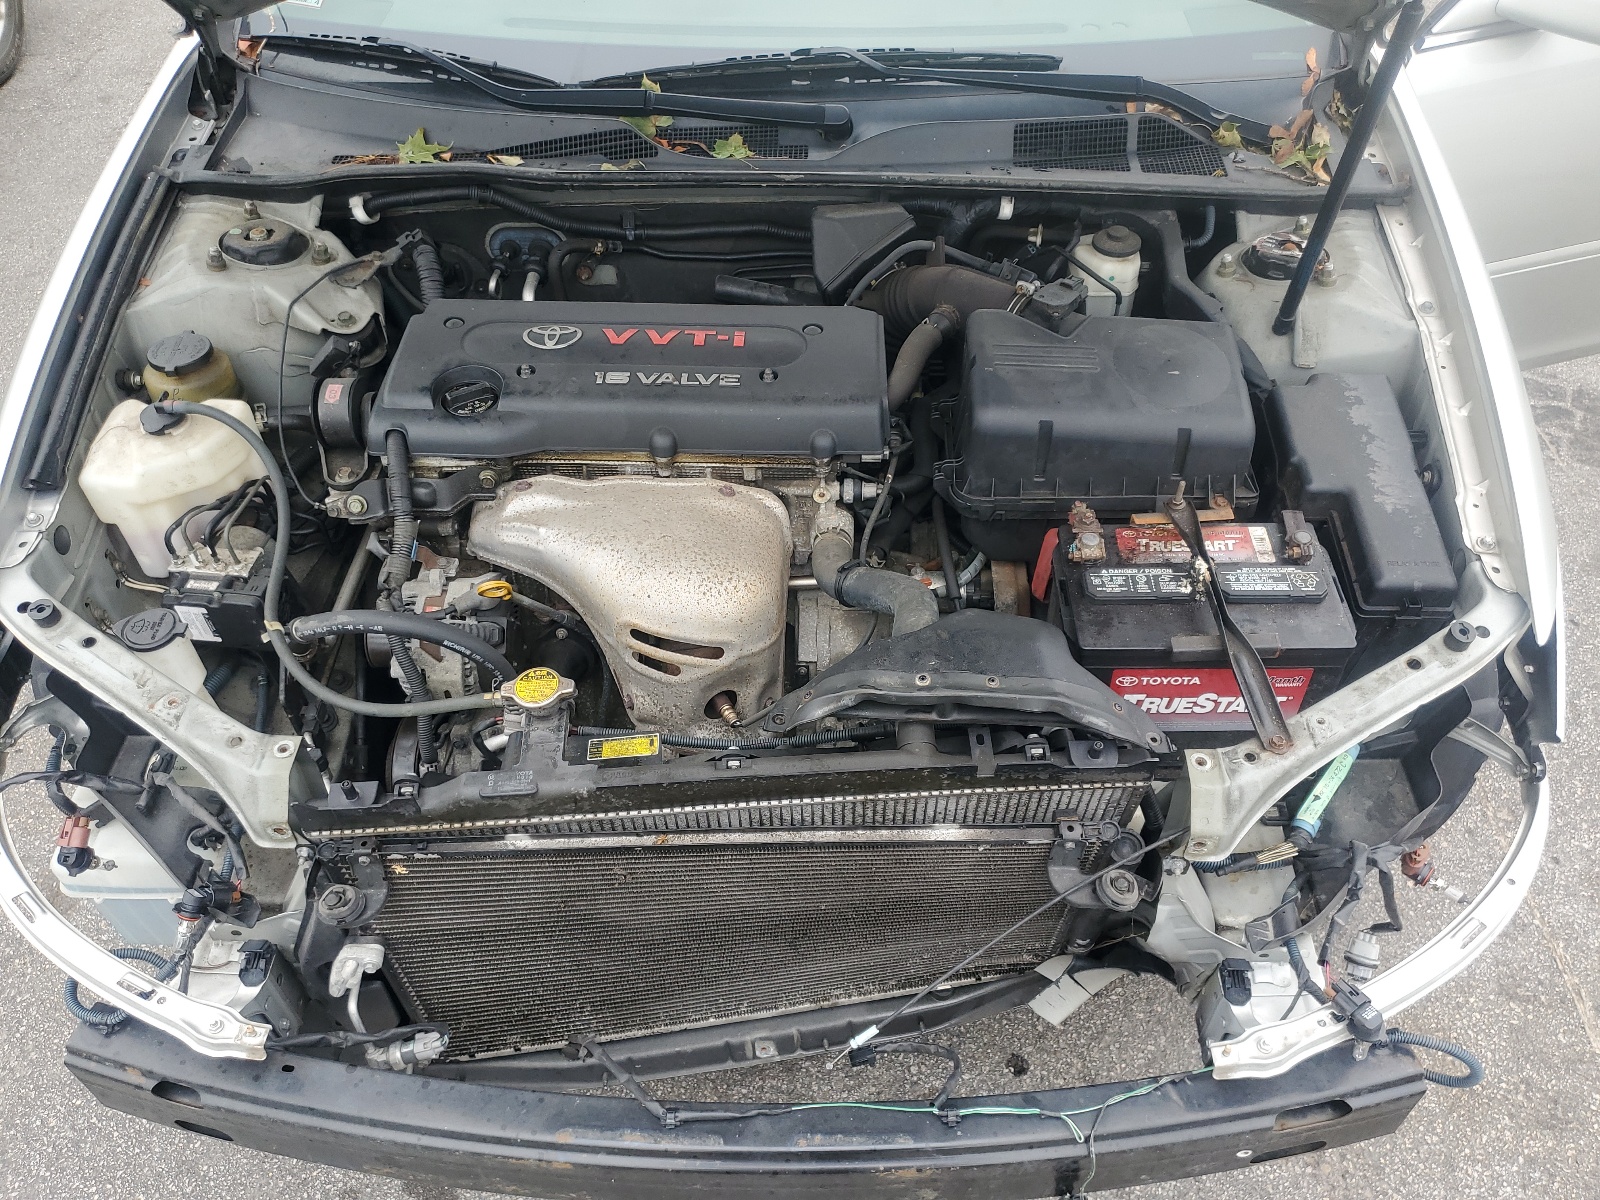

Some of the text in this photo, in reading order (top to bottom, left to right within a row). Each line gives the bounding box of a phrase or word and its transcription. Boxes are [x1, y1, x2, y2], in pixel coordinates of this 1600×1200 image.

[602, 328, 746, 347] VVT-i
[594, 371, 741, 387] 16 VALVE
[1137, 538, 1236, 552] TRUESART
[1140, 676, 1202, 686] TOYOTA
